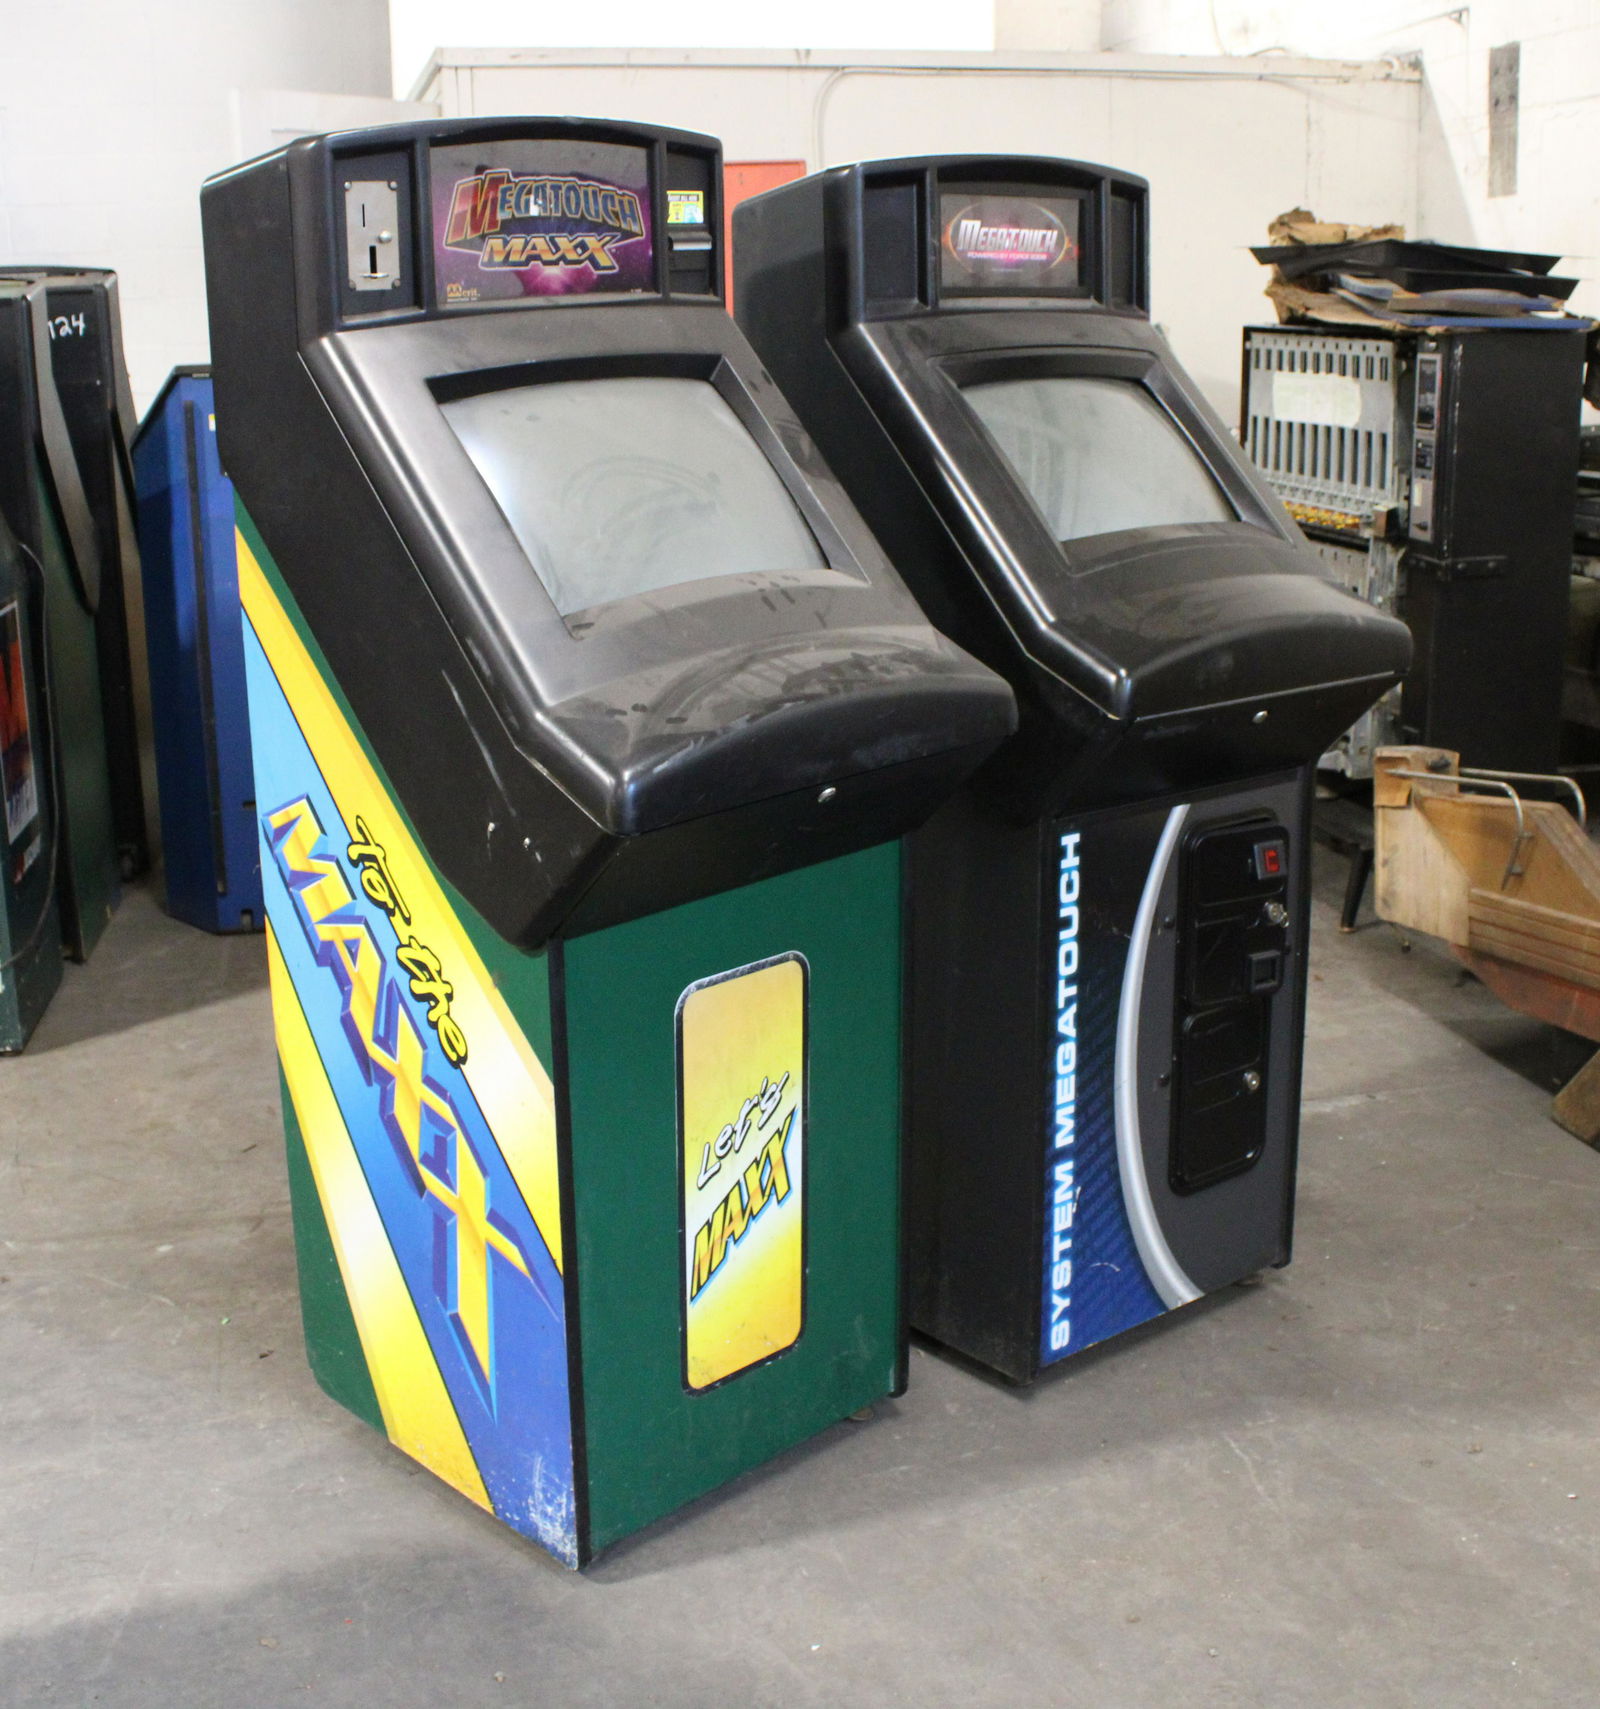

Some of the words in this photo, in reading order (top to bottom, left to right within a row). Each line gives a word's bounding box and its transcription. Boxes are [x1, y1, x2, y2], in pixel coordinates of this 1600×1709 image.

[445, 171, 643, 245] MEGATOUCH
[481, 235, 617, 270] MAXX
[957, 219, 1058, 252] MEGATOUCH
[48, 312, 85, 340] 124
[396, 935, 468, 1069] the
[1054, 832, 1082, 1149] MEGATOUCH
[263, 793, 556, 1422] MAXX
[697, 1071, 790, 1190] Let's
[690, 1105, 799, 1302] MAXX
[1050, 1175, 1076, 1351] SYSTEM
